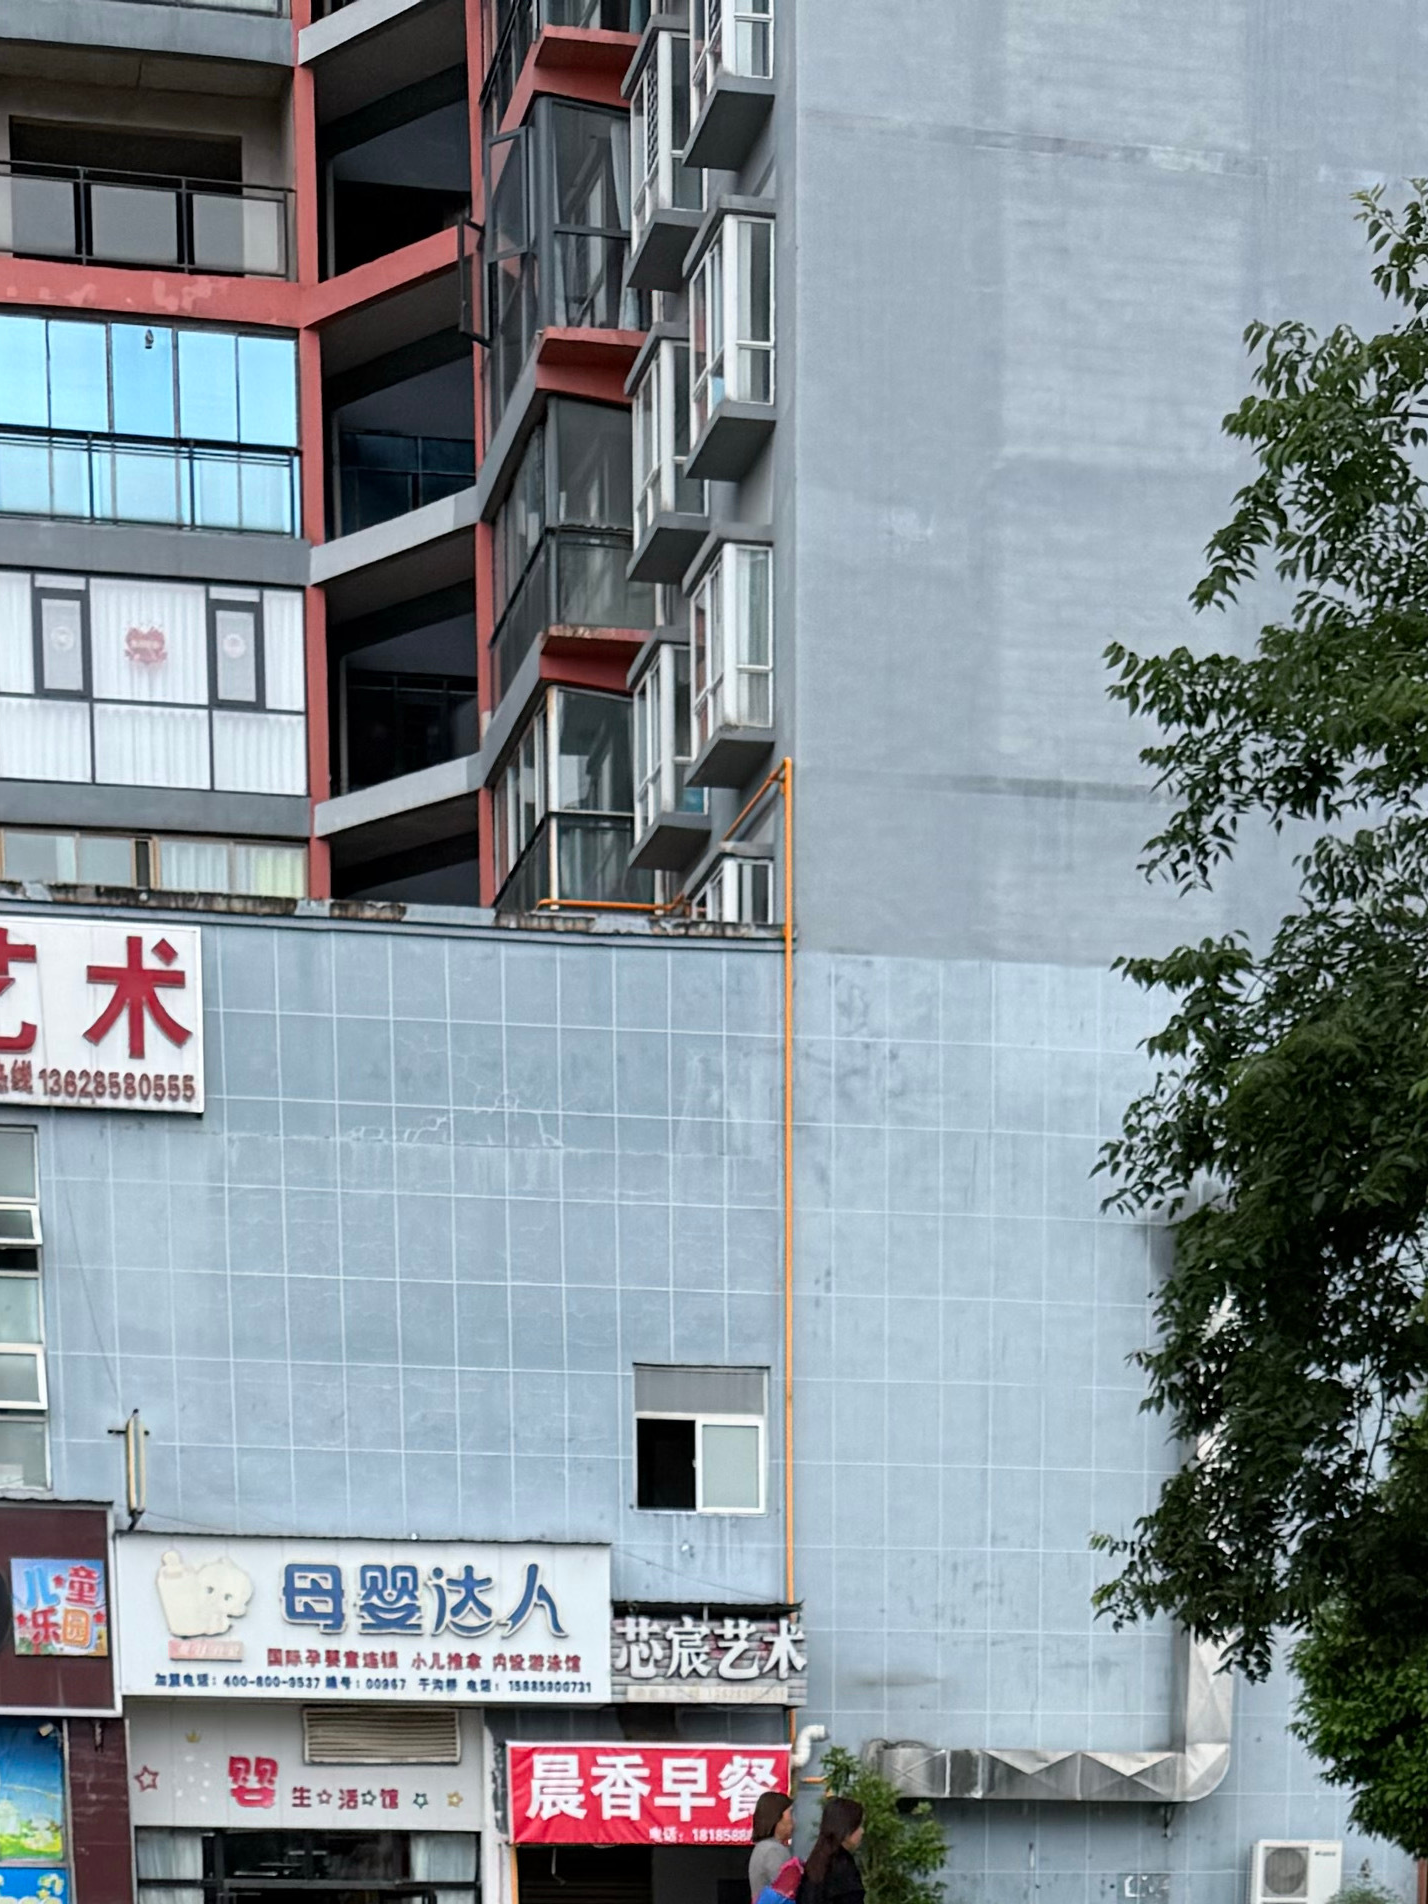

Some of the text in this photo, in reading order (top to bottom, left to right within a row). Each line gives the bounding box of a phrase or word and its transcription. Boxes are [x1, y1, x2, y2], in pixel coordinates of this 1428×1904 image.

[23, 1566, 103, 1609] 儿童
[281, 1561, 569, 1638] 母婴达人
[411, 1652, 482, 1672] 小儿推拿
[614, 1614, 808, 1681] 芯宸艺术
[525, 1754, 779, 1823] 晨香早餐
